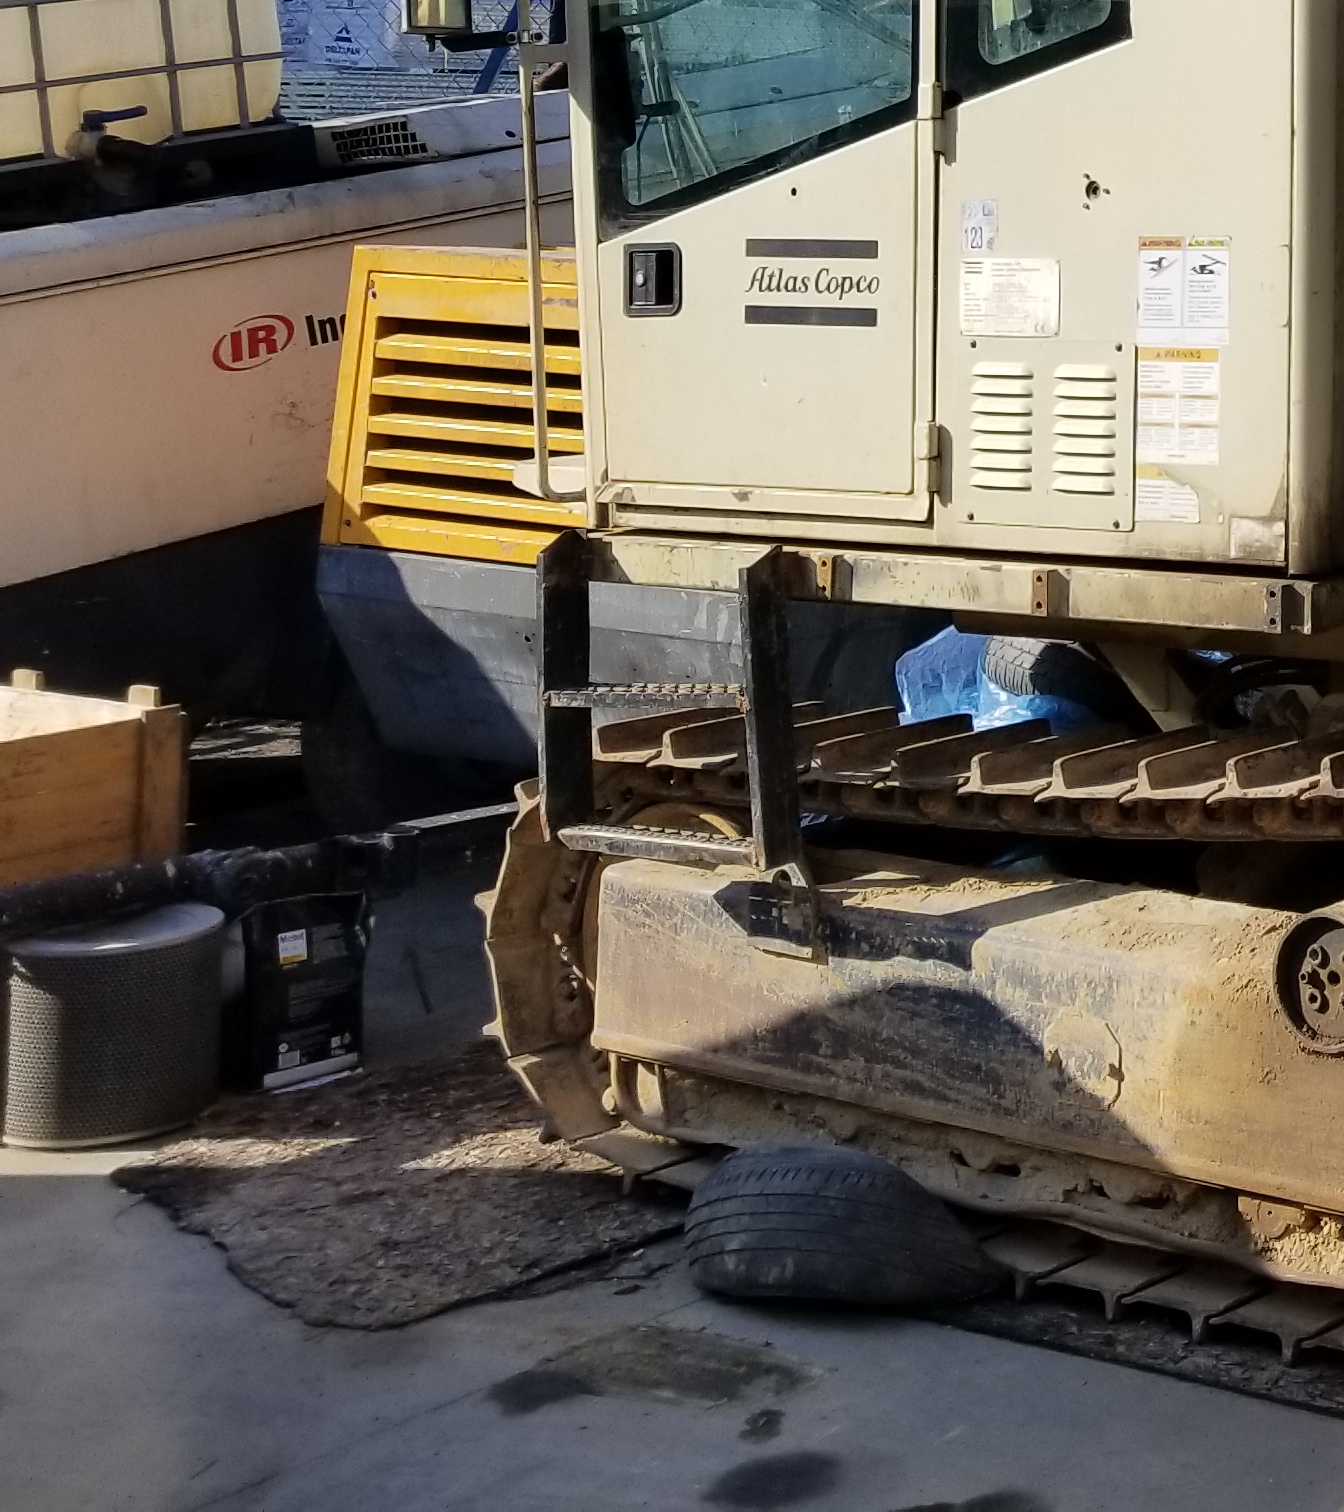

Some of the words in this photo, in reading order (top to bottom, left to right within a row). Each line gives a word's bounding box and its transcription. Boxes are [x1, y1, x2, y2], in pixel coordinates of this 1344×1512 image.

[745, 266, 810, 294] Atlas
[814, 267, 880, 301] Copco
[230, 324, 279, 364] IR
